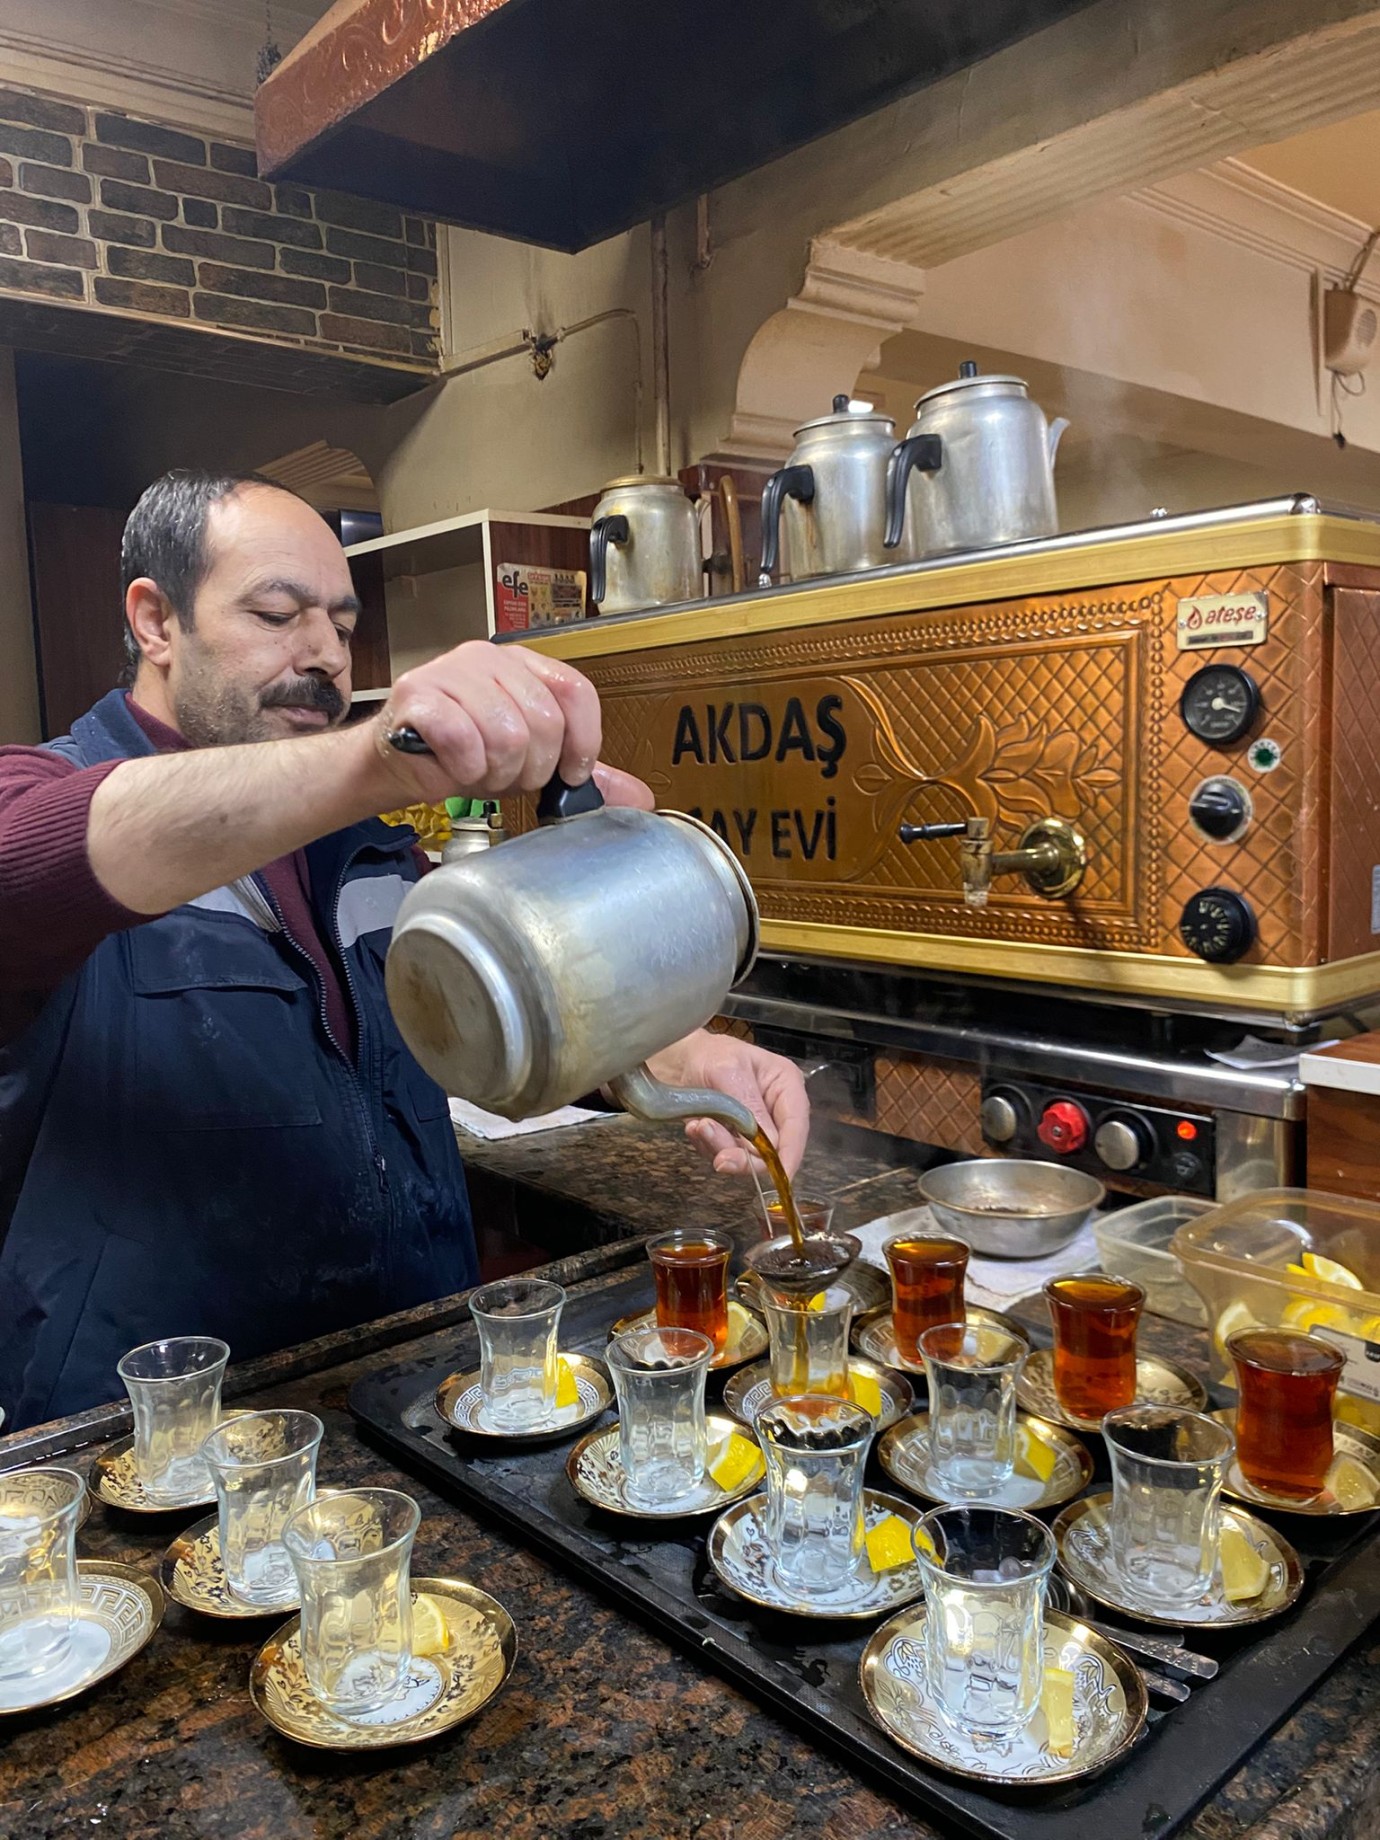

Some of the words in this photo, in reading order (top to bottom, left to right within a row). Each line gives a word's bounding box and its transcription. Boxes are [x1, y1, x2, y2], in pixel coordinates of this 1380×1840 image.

[502, 571, 528, 598] efe
[1205, 605, 1257, 625] ateşe
[672, 694, 848, 778] AKDAŞ
[686, 807, 757, 856] AY
[772, 796, 838, 861] EVİ
